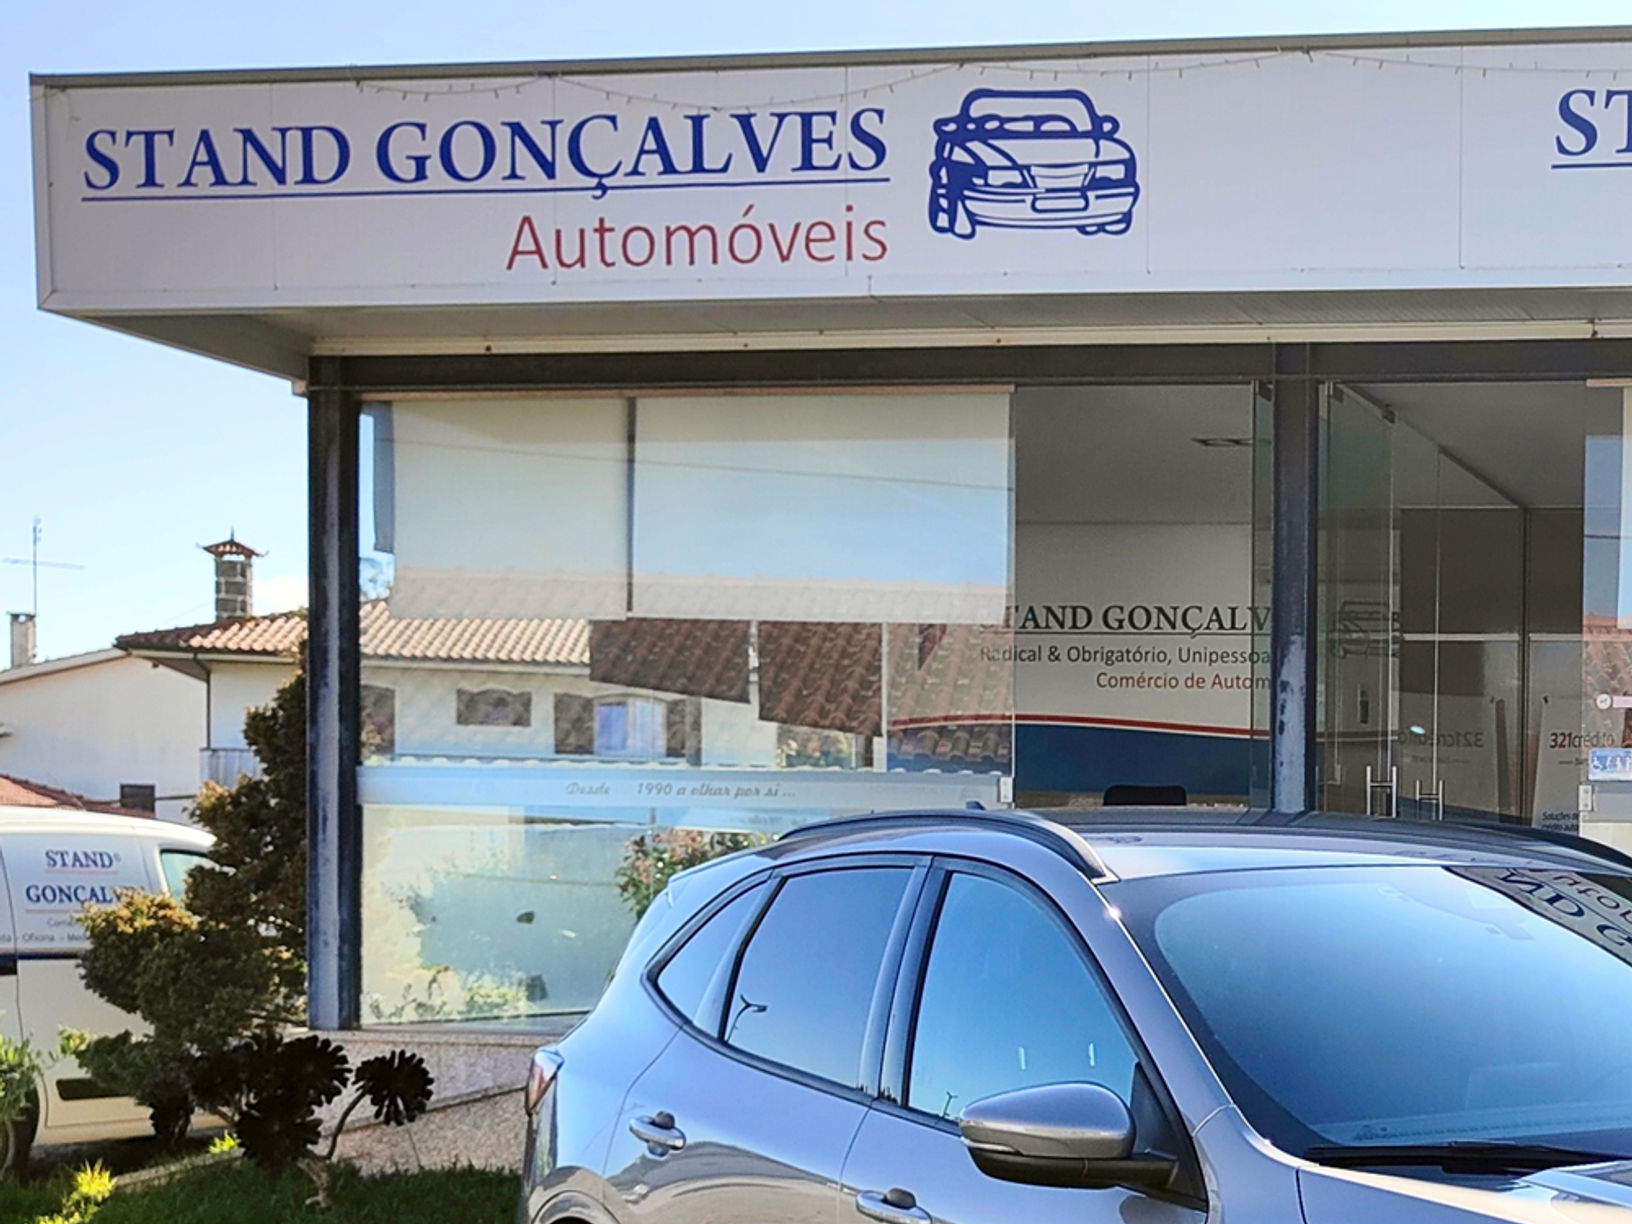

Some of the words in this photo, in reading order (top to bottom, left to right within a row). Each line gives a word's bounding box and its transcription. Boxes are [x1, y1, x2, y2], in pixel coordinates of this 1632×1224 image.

[83, 125, 351, 190] STAND
[376, 107, 888, 199] GONÇALVES
[506, 205, 888, 272] Automóveis
[986, 604, 1094, 630] TAND
[1102, 605, 1272, 639] GONÇALV
[1047, 646, 1062, 662] &
[1067, 646, 1172, 667] Obrigatório,
[1178, 647, 1272, 667] Unipessoa
[1096, 671, 1179, 689] Comércio
[1184, 673, 1206, 689] de
[1210, 673, 1272, 690] Autom
[566, 781, 611, 796] Desde
[637, 782, 673, 796] 1990
[676, 786, 686, 796] a
[690, 783, 731, 797] olhar
[734, 786, 760, 799] por
[764, 783, 780, 797] si
[45, 850, 113, 869] STAND
[26, 883, 126, 904] GONÇAL
